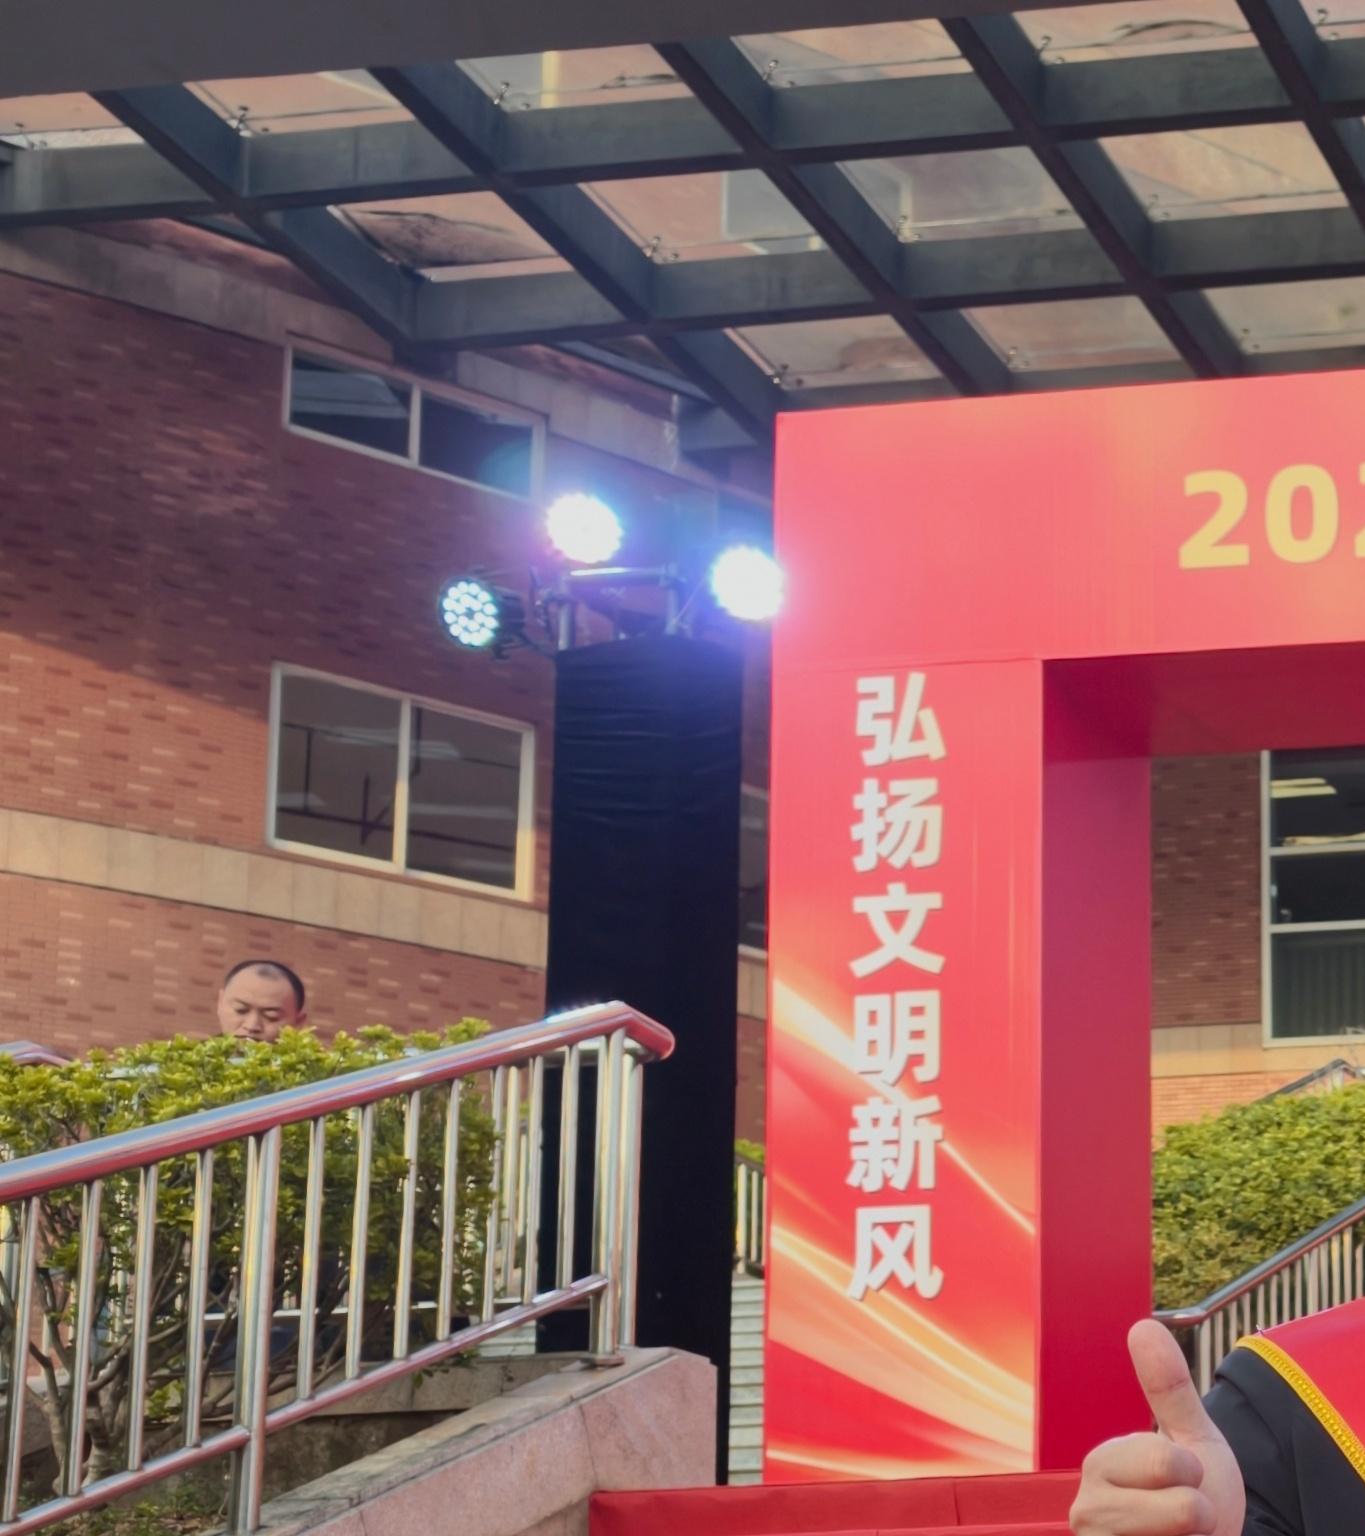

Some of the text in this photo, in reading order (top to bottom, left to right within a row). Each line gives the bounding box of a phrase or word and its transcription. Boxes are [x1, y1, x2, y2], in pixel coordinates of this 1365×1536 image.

[846, 671, 948, 1302] 弘扬文明新风
